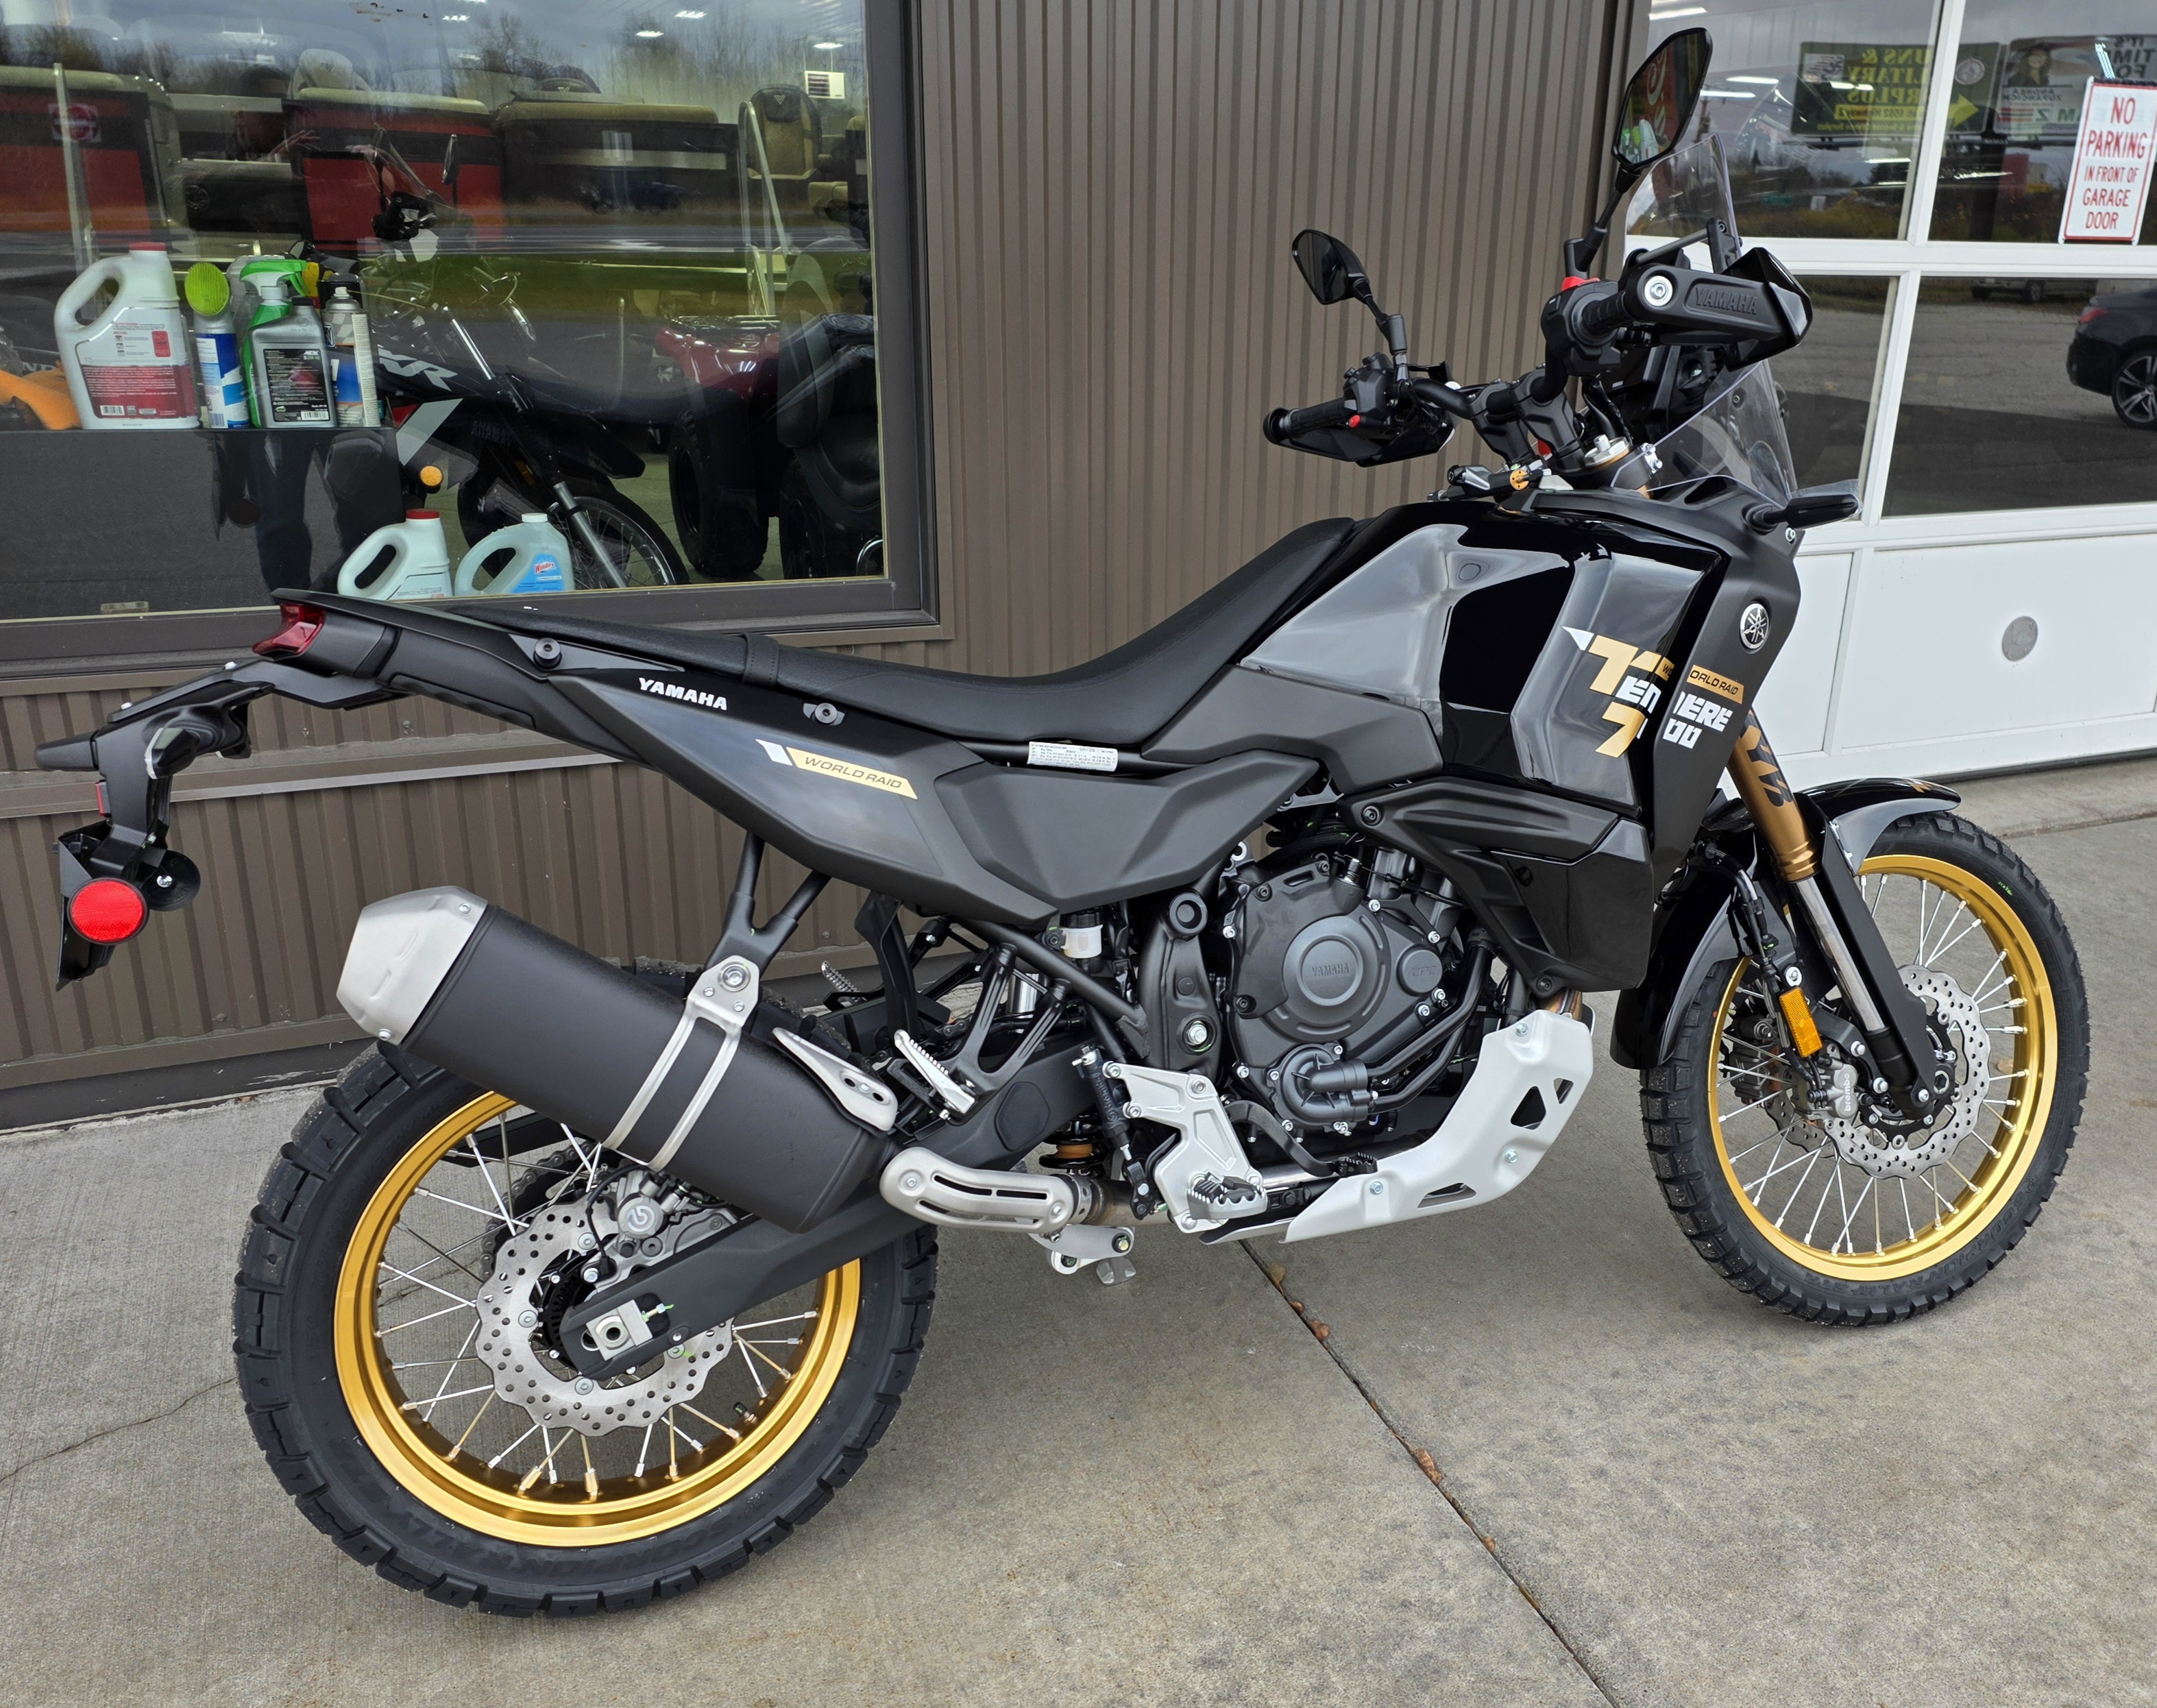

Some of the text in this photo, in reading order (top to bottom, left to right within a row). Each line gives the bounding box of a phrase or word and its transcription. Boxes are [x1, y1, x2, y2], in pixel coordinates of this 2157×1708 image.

[2110, 97, 2136, 125] NO
[2085, 130, 2147, 159] PARKING
[2084, 165, 2139, 183] IN FRONT OF
[2082, 188, 2131, 208] GARAGE
[2085, 211, 2119, 230] DOOR
[1695, 287, 1757, 315] YAMAHA
[639, 677, 727, 711] YAMAHA
[1718, 681, 1740, 696] RAID
[805, 756, 903, 789] WORLD RAID
[1312, 962, 1350, 977] YAMAHA
[1843, 1073, 1852, 1112] brembo
[515, 1513, 734, 1575] SCORPION
